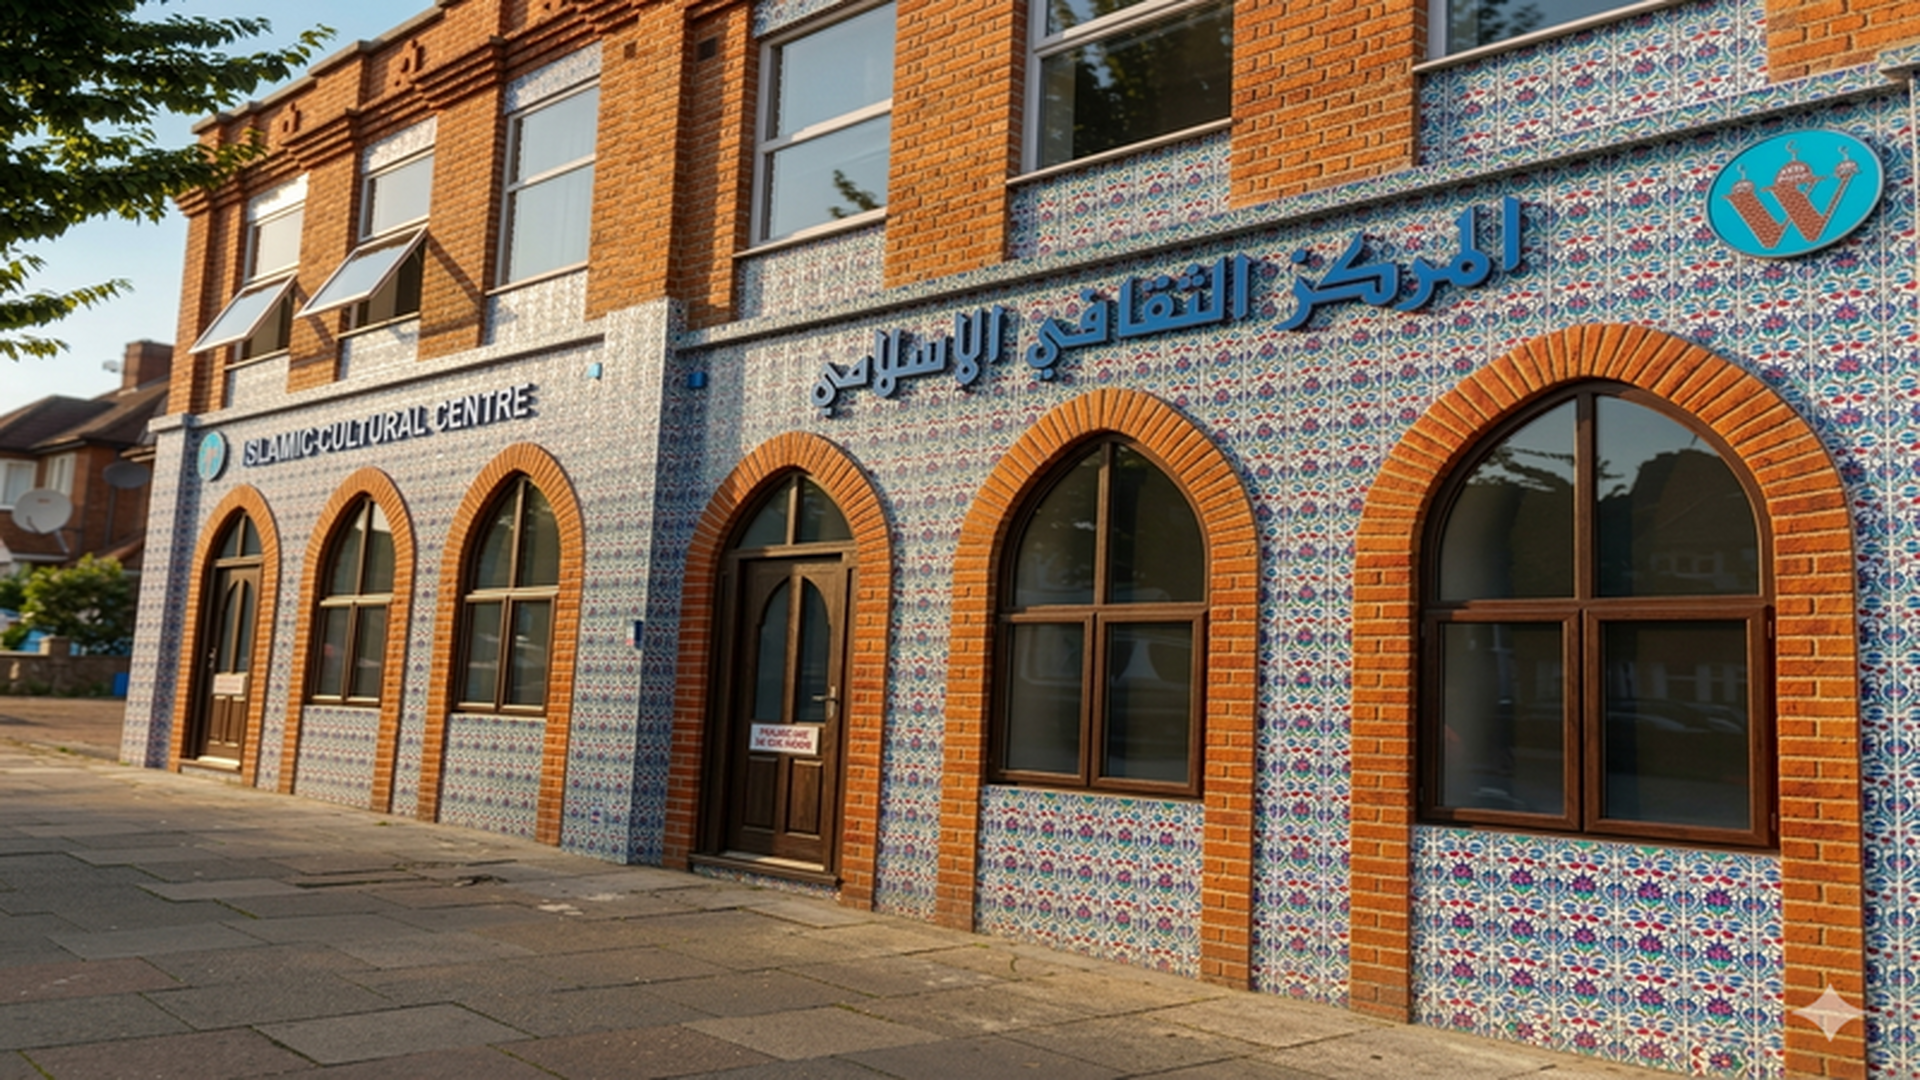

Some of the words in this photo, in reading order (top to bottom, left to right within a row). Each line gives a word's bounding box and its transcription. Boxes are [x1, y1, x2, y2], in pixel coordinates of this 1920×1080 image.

[1026, 251, 1251, 380] الثقافي
[1273, 195, 1520, 331] المركز
[436, 383, 531, 430] CENTRE
